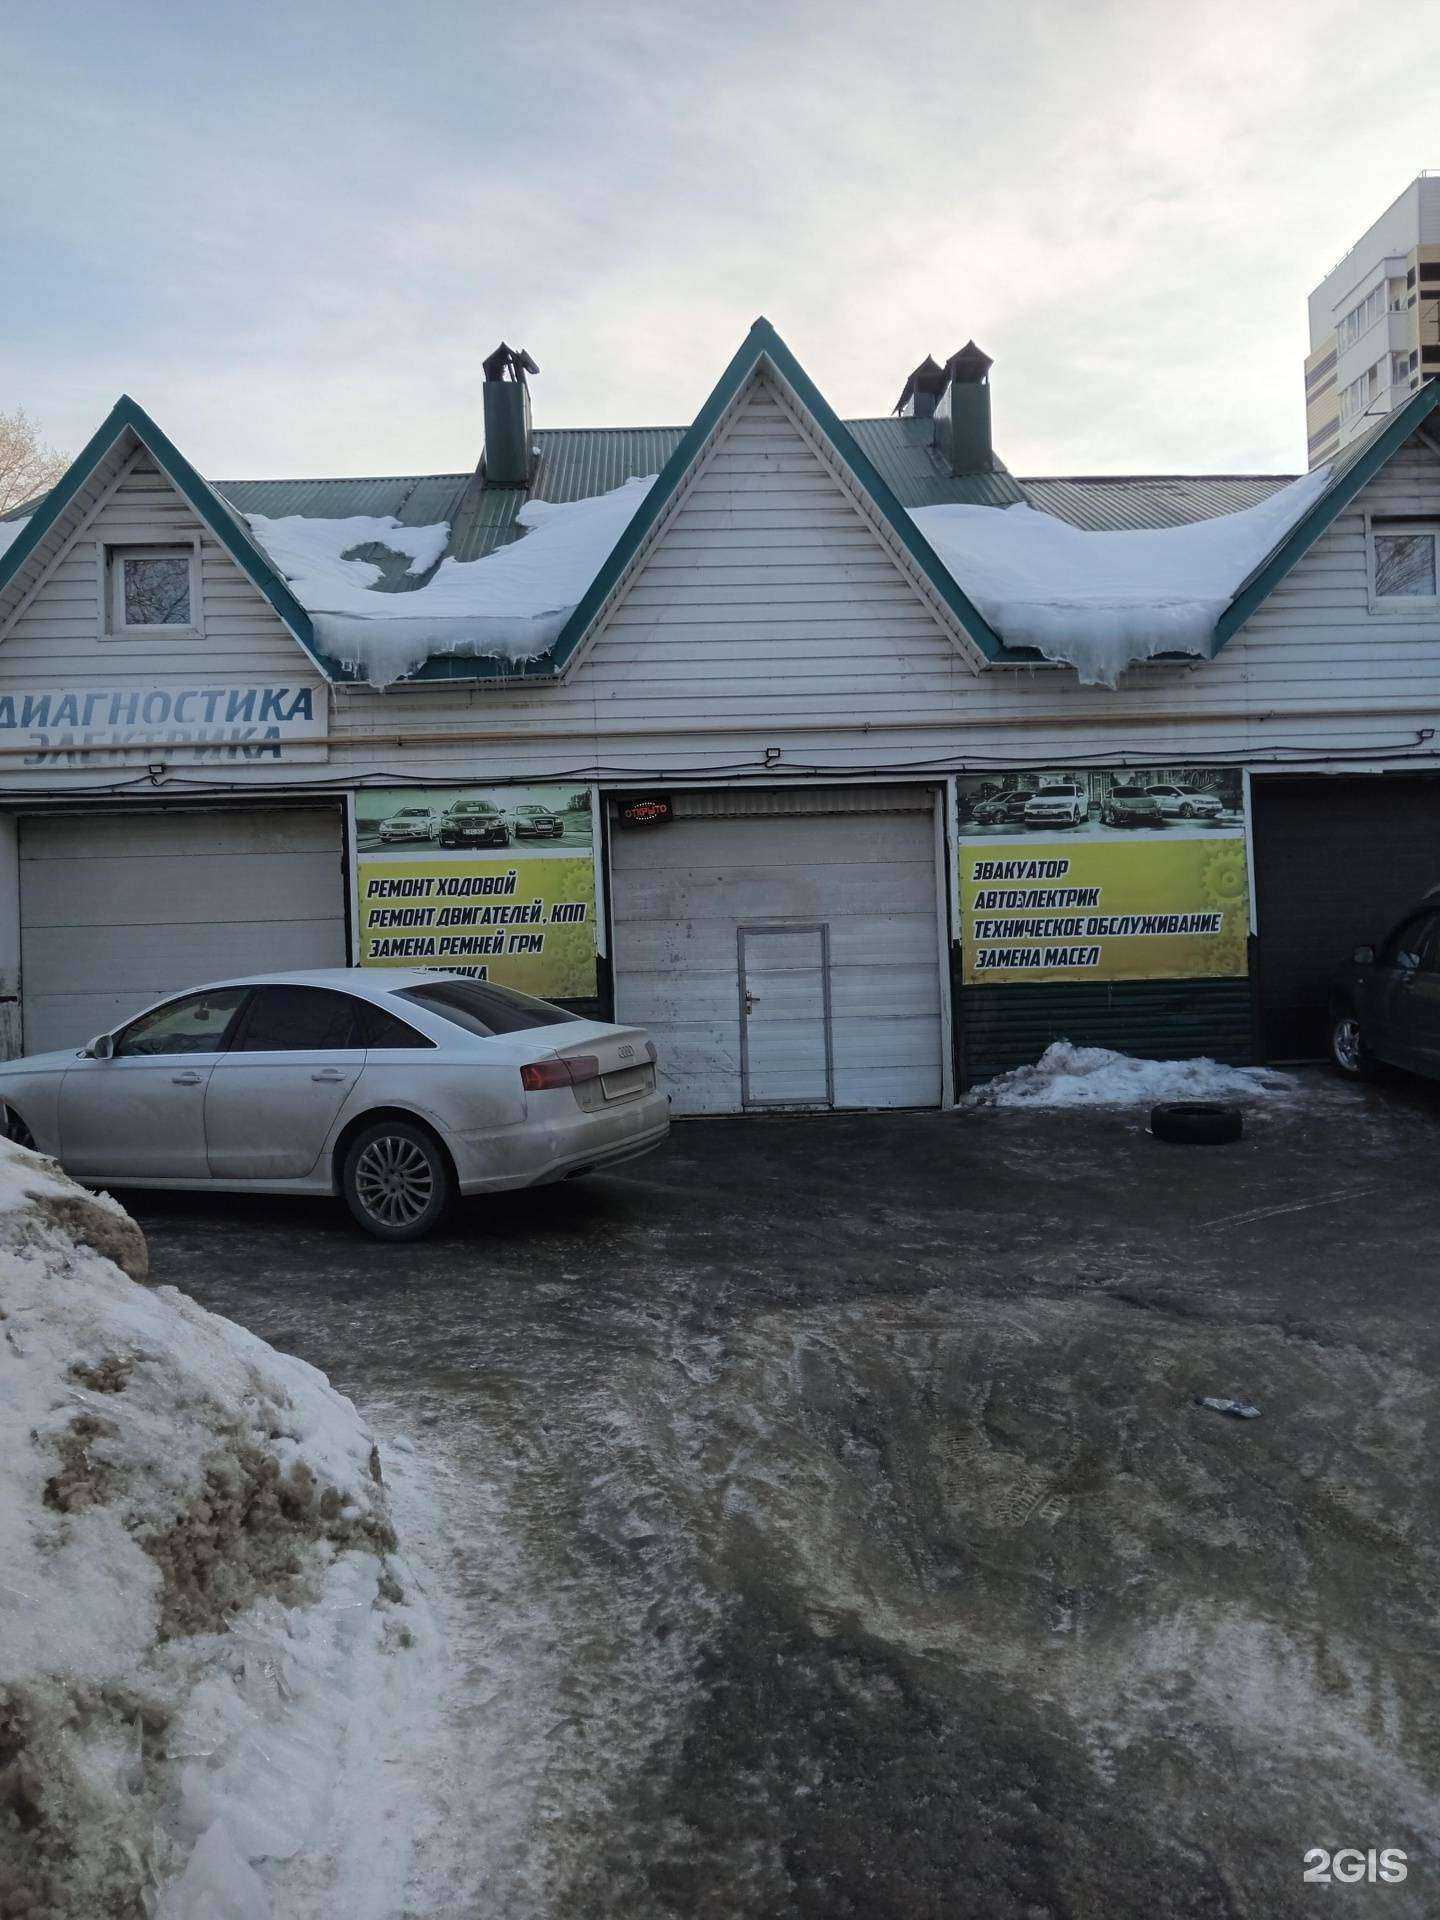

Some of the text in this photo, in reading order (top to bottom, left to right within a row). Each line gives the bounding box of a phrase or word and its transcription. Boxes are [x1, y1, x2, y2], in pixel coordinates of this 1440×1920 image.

[0, 687, 315, 729] ДИАГНОСТИКА
[624, 803, 667, 818] ОТКРЫТО
[973, 860, 1070, 881] ЭВАКУАТОР
[367, 870, 518, 898] РЕМОНТ ХОДОВОЙ
[974, 888, 1101, 910] АВТОЭЛЕКТРИК
[368, 907, 436, 928] РЕМОНТ
[551, 903, 587, 923] КПП
[973, 913, 1222, 939] ТЕХНИЧЕСКОЕ ОБСЛУЖИВАНИЕ
[369, 929, 544, 958] ЗАМЕНА РЕМНЕЙ ГРМ
[975, 946, 1101, 968] ЗАМЕНА МАСЕЛ
